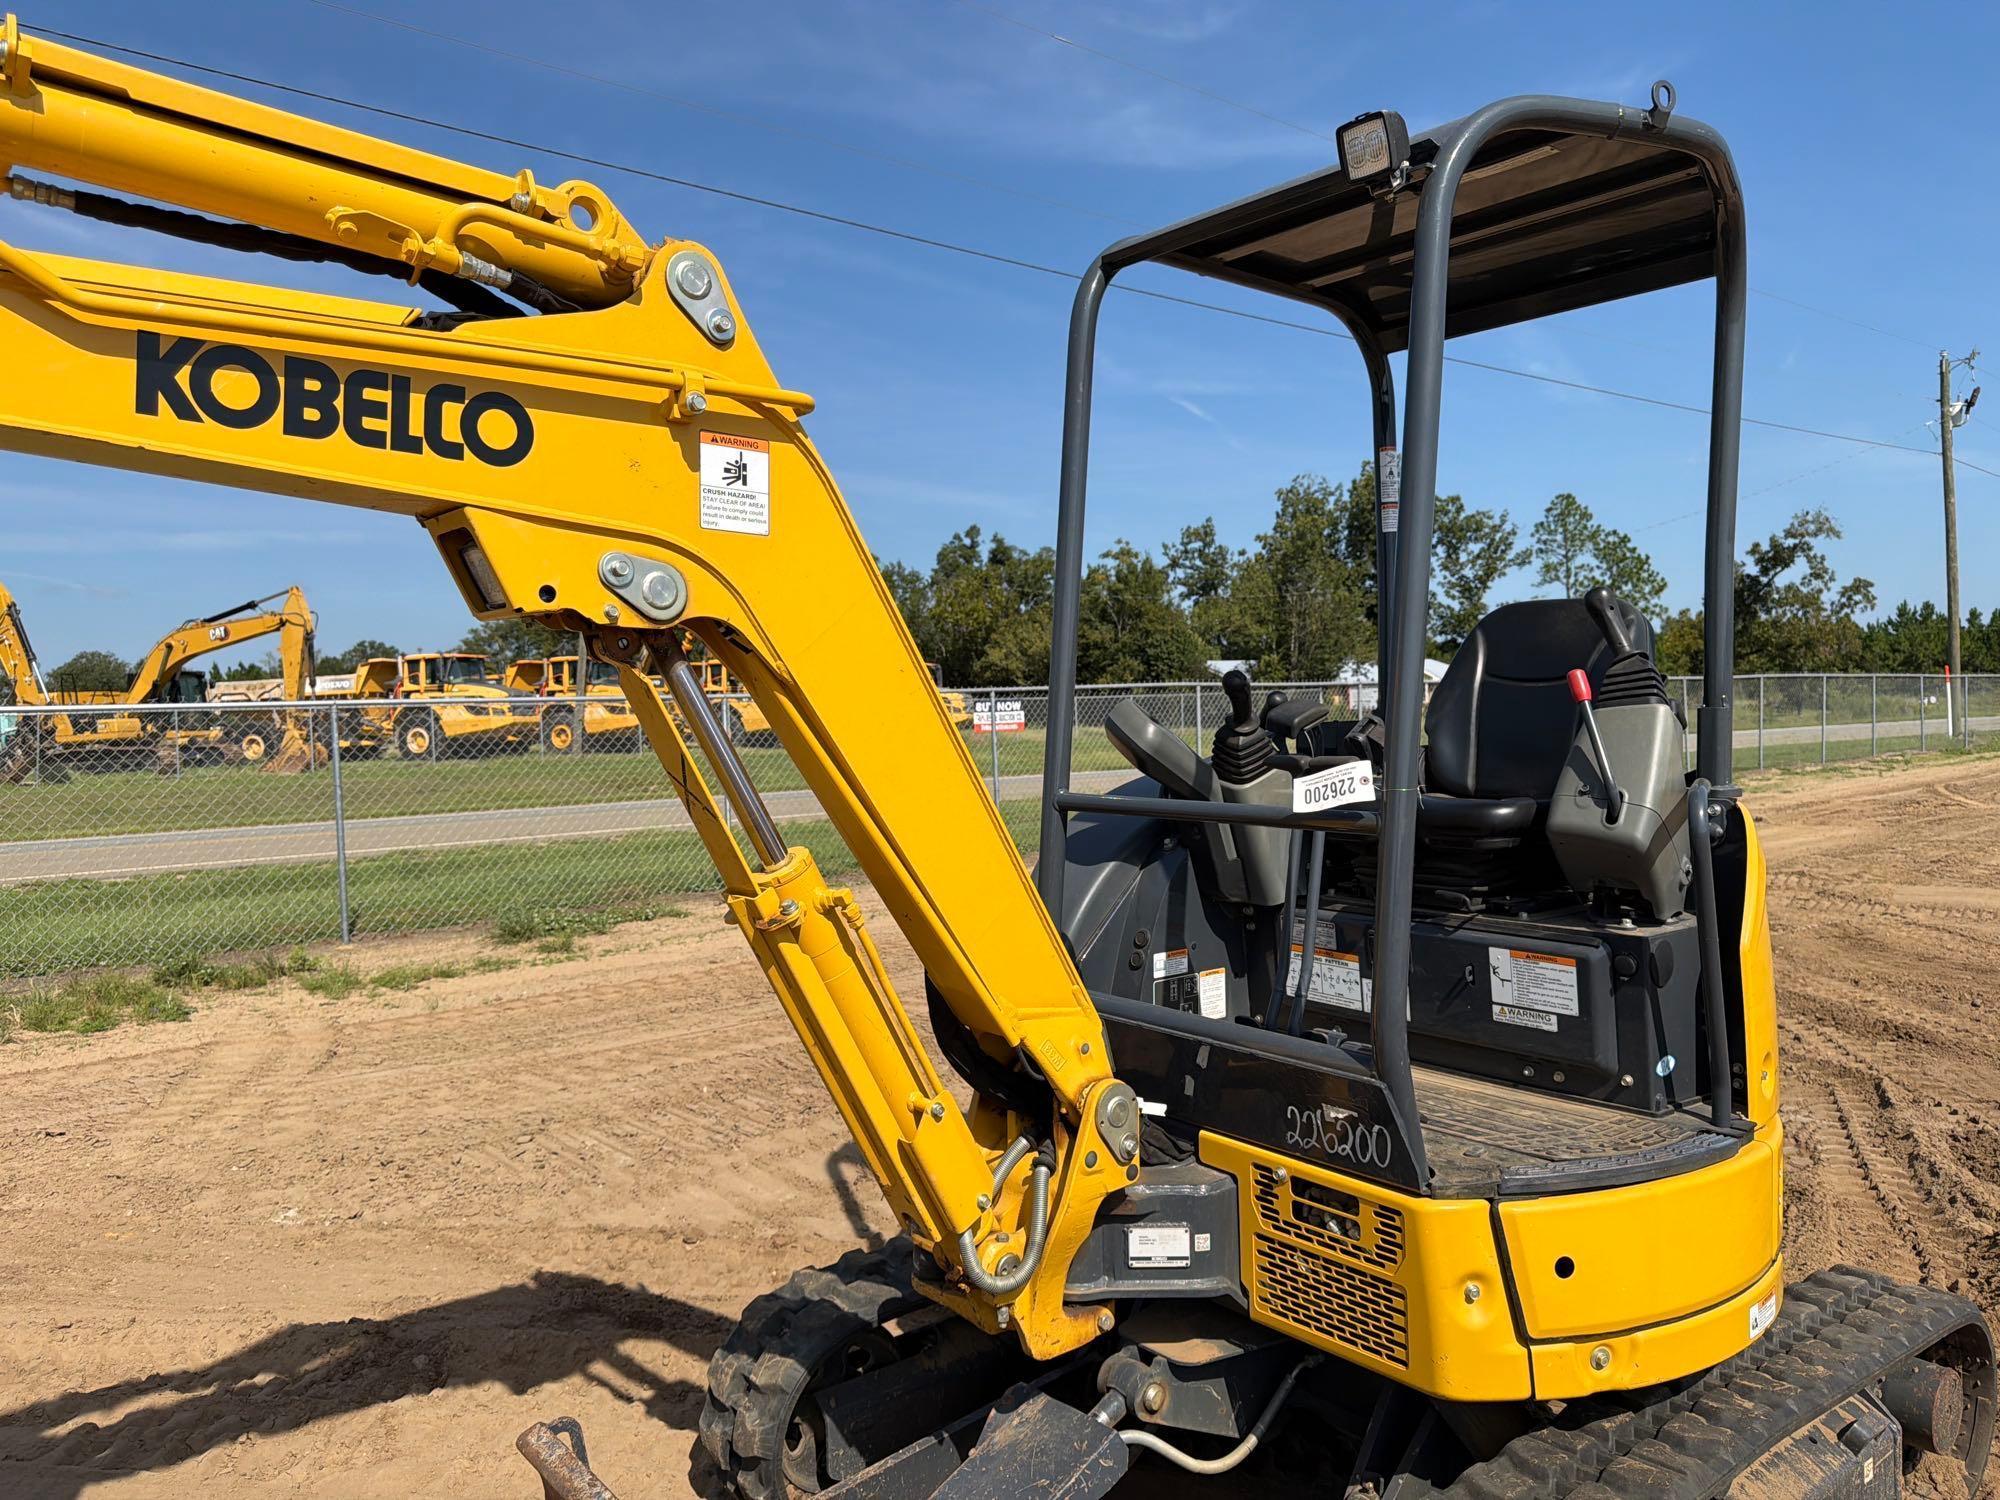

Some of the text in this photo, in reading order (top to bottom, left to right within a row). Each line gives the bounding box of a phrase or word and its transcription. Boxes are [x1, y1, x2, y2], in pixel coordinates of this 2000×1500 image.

[135, 329, 535, 468] KOBELCO
[719, 435, 759, 450] WARNING
[702, 488, 757, 500] CRUSH HAZARD!
[719, 497, 739, 505] CLEAR
[702, 503, 721, 511] Failure
[728, 507, 748, 515] comply
[748, 517, 767, 525] serious
[209, 626, 225, 640] CAT
[316, 678, 350, 689] VOLVO
[997, 701, 1022, 711] NOW
[1304, 777, 1355, 804] 226200
[1324, 959, 1349, 967] PATTERN
[1530, 954, 1558, 962] WARNING
[1507, 1007, 1552, 1022] WARNING
[1286, 1105, 1392, 1168] 226200
